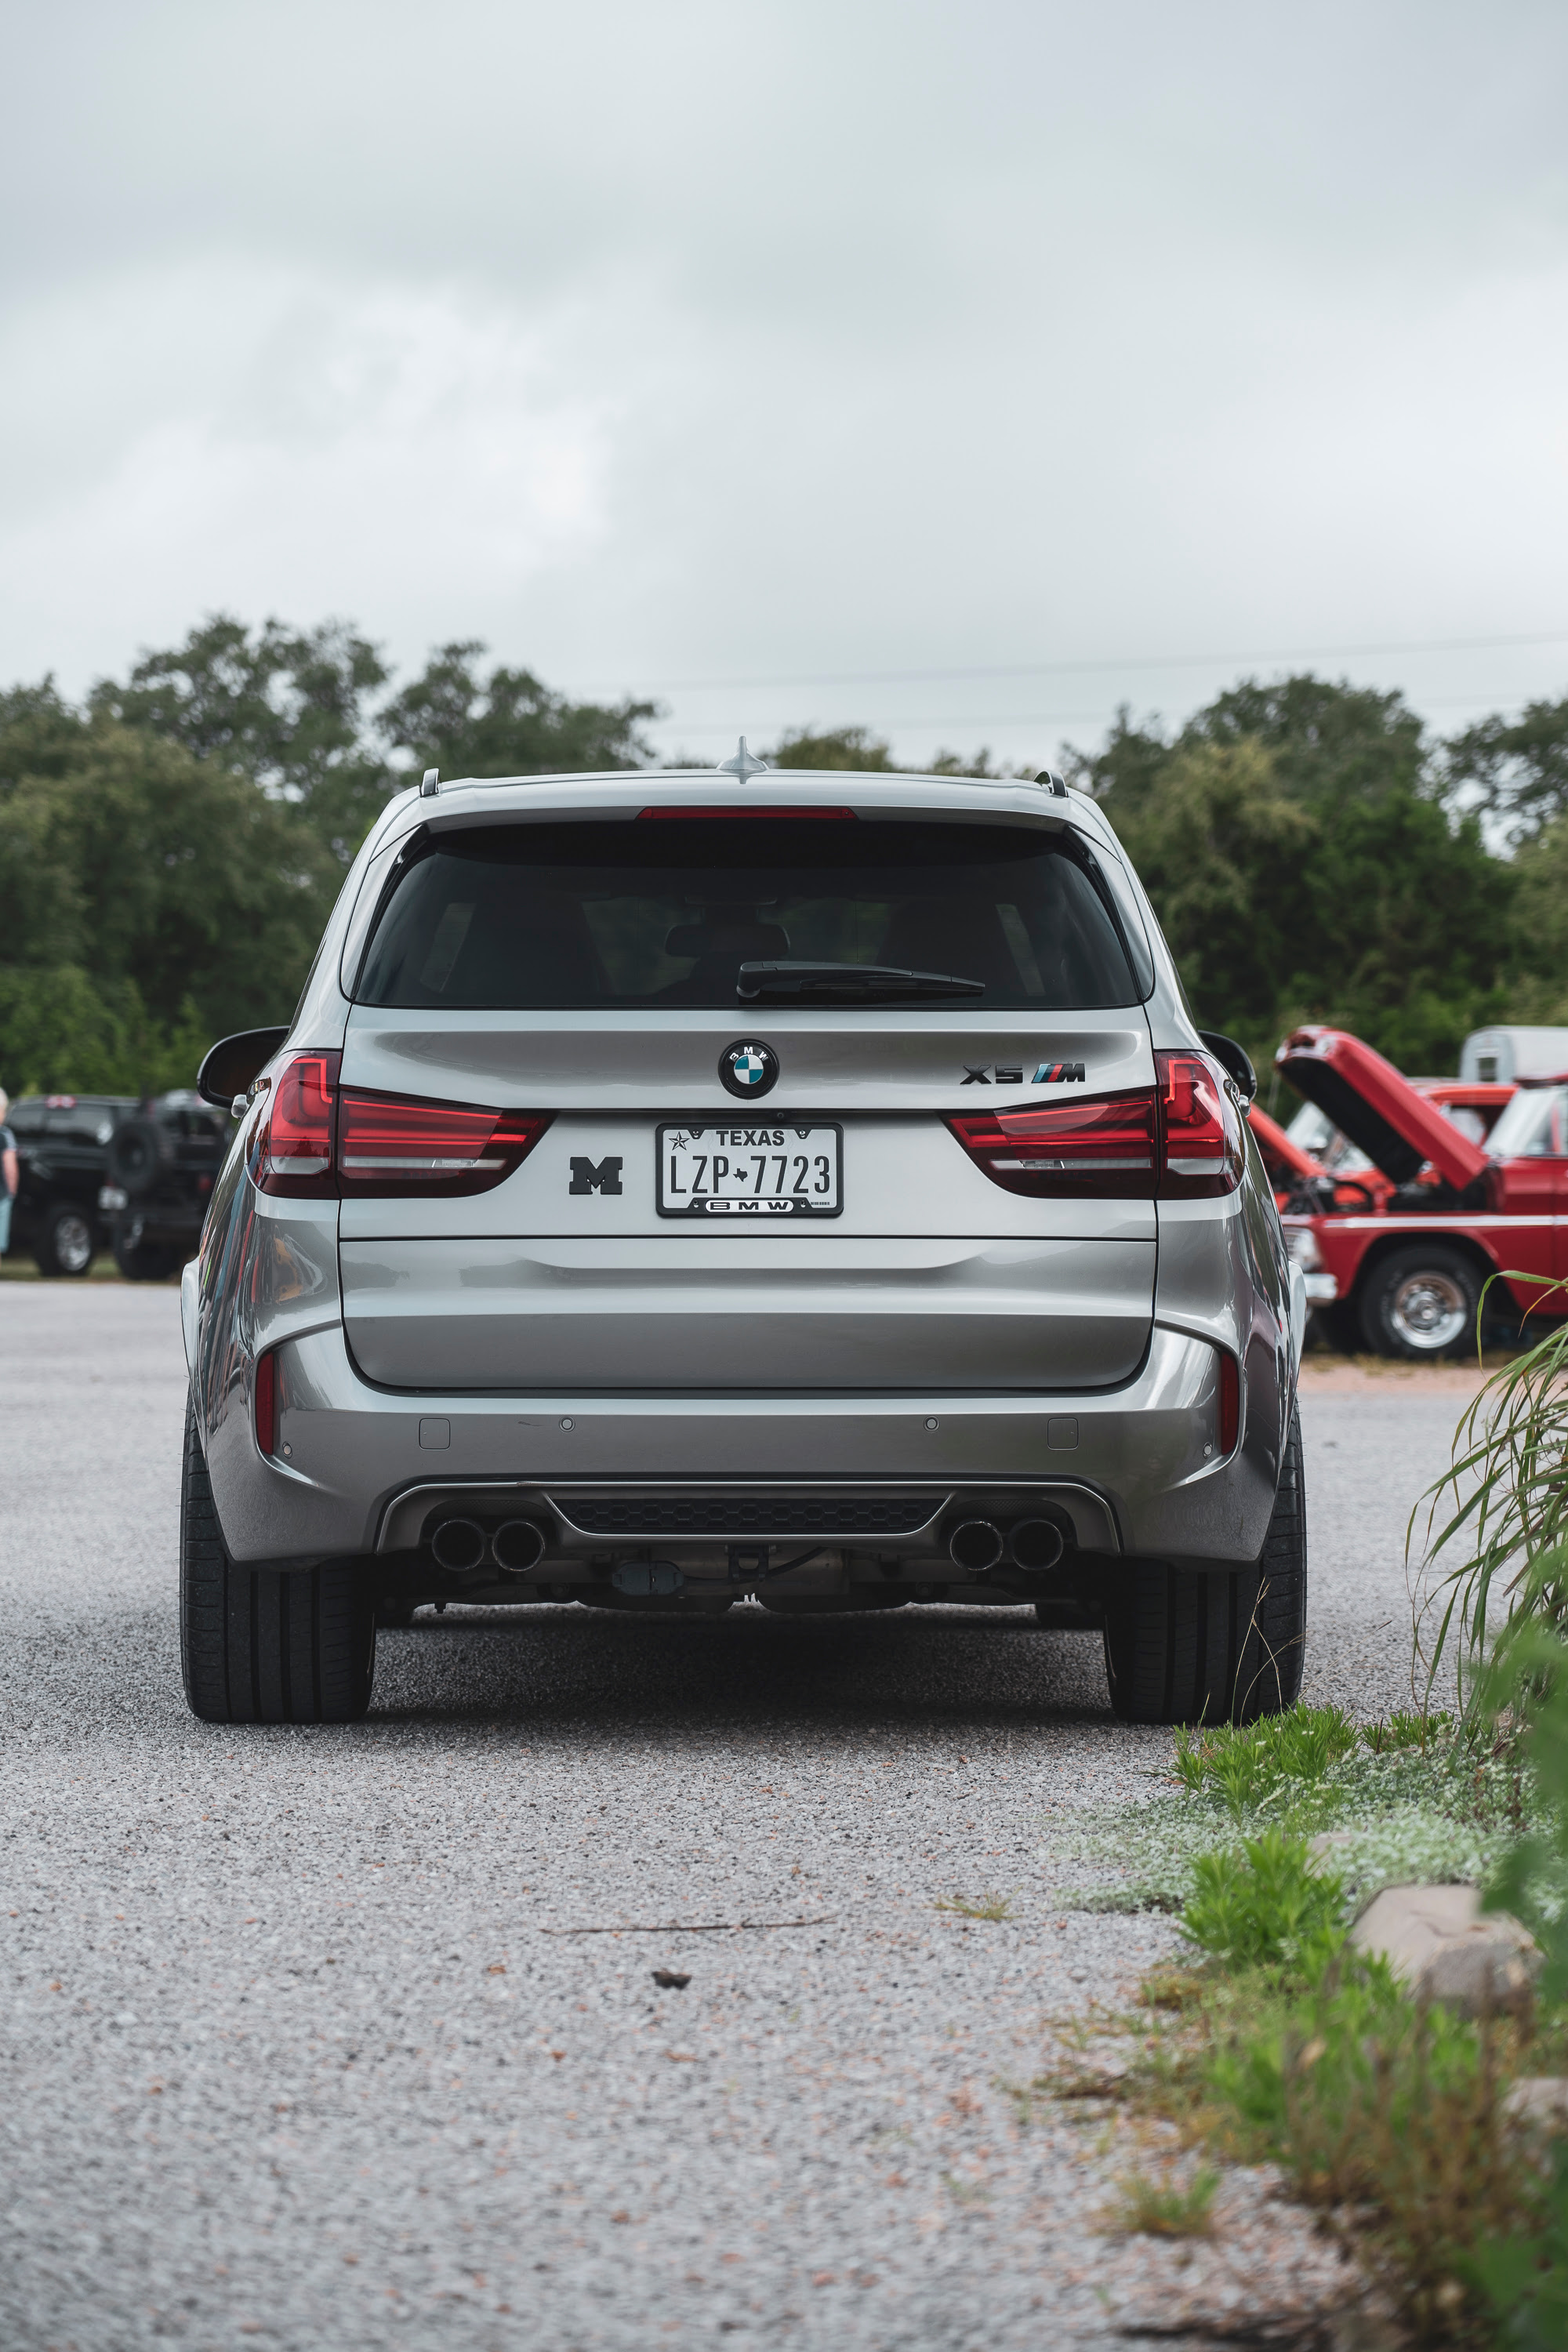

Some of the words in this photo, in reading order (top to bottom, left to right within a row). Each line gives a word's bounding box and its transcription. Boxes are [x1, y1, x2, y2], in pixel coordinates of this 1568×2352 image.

[729, 1046, 769, 1062] BMW
[960, 1064, 1023, 1084] X5
[1054, 1063, 1085, 1083] M
[716, 1130, 785, 1145] TEXAS
[569, 1156, 622, 1195] M
[670, 1156, 729, 1193] LZP
[750, 1156, 829, 1193] 7723
[710, 1202, 789, 1210] BMW
